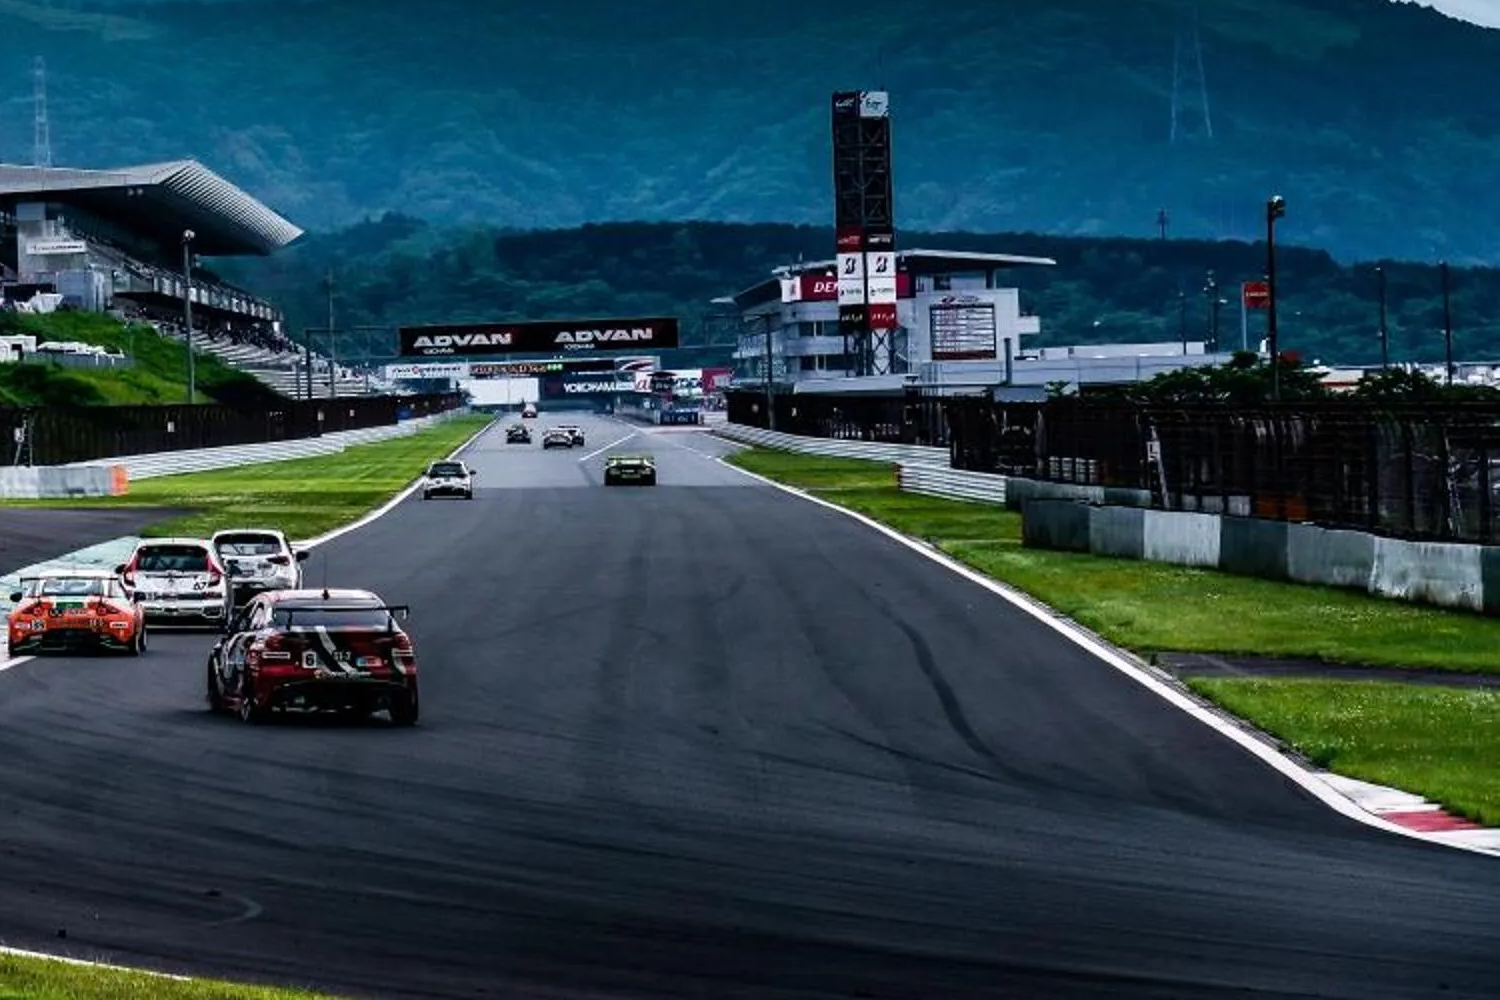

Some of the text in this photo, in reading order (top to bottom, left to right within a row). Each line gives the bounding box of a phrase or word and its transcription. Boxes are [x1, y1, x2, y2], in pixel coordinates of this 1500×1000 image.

[413, 332, 512, 348] ADVAN
[554, 328, 652, 343] ADVAN
[563, 381, 617, 393] YOKOHAM
